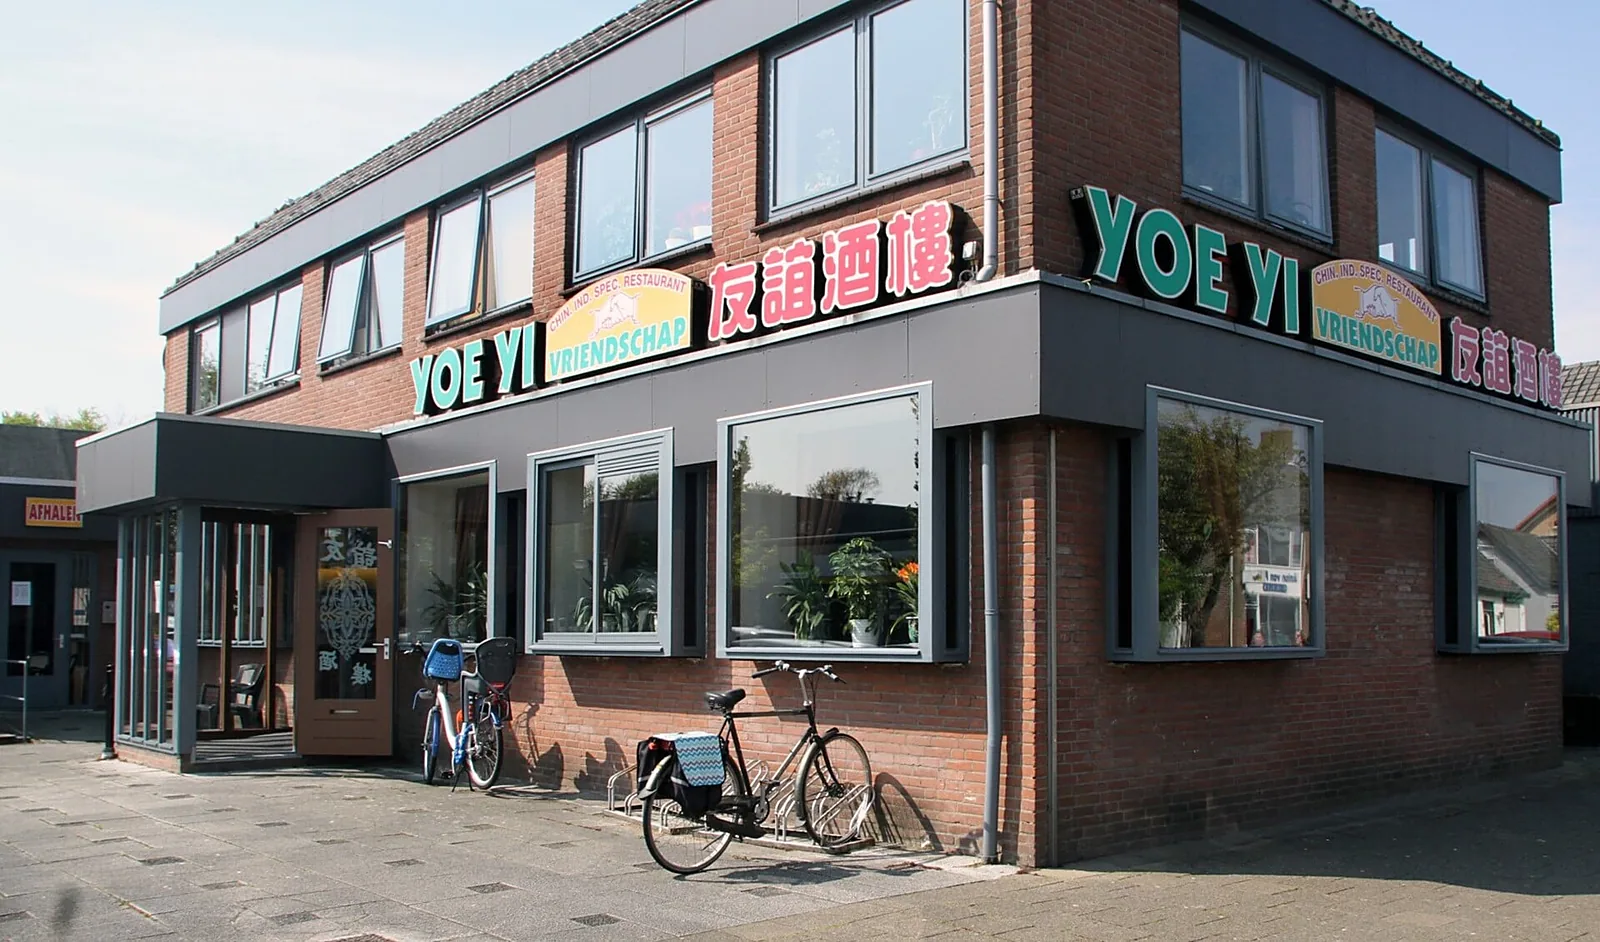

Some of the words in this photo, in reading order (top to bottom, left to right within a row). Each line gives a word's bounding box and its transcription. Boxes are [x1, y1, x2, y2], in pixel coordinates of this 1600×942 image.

[707, 200, 952, 342] 友誼酒樓
[1085, 184, 1229, 314] YOE
[1243, 241, 1300, 334] YI
[1315, 265, 1339, 284] CHIN.
[1340, 264, 1358, 279] IND.
[1360, 264, 1384, 283] SPEC.
[1386, 273, 1437, 322] RESTAURANT
[549, 305, 573, 332] CHIN.
[574, 293, 592, 312] IND.
[594, 278, 621, 298] SPEC.
[623, 273, 687, 293] RESTAURANT
[1316, 307, 1439, 369] VRIENDSCHAP
[410, 338, 484, 415] YOE
[493, 321, 536, 393] YI
[549, 316, 686, 376] VRIENDSCHAP
[1450, 316, 1562, 410] 友誼酒樓
